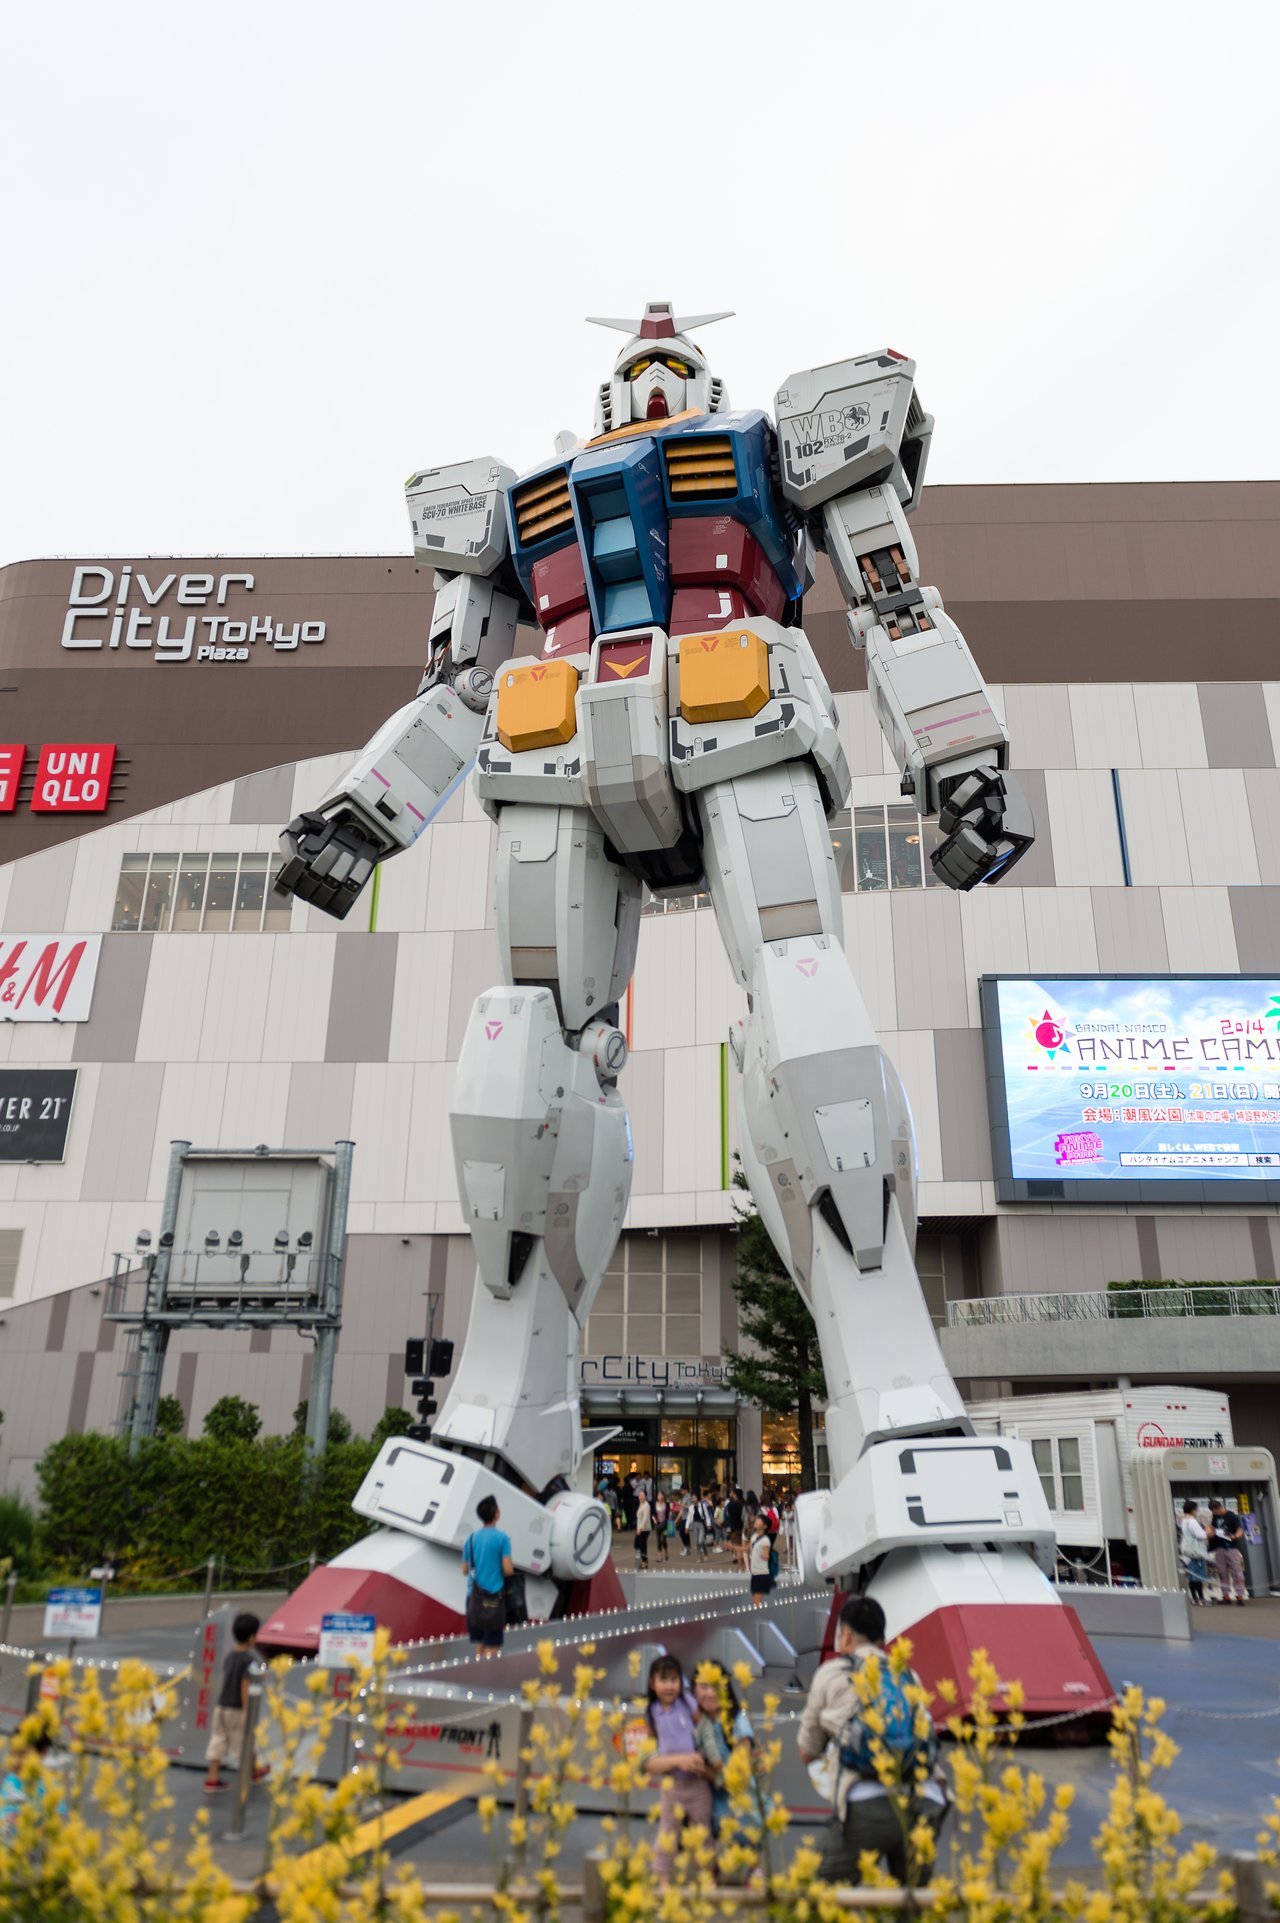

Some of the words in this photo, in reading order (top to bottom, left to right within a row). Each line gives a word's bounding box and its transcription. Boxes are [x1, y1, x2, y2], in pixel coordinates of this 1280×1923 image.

[790, 409, 844, 445] WB
[795, 440, 824, 459] 102
[823, 432, 852, 445] RX-78-2
[422, 508, 446, 520] SCV-70
[68, 565, 254, 606] Diver
[60, 608, 196, 661] City
[197, 645, 249, 661] Plaza
[47, 753, 100, 774] UNI
[41, 779, 100, 806] QLO
[1075, 1024, 1120, 1033] BANDAI
[1124, 1024, 1167, 1033] NAMCO
[1220, 1019, 1265, 1035] 2014
[1077, 1038, 1193, 1060] ANIME
[39, 1097, 61, 1119] 21
[0, 1124, 20, 1132] .CO.JP
[1060, 1141, 1103, 1152] ANIME
[581, 1356, 669, 1388] rCity
[196, 1624, 216, 1729] ENTER
